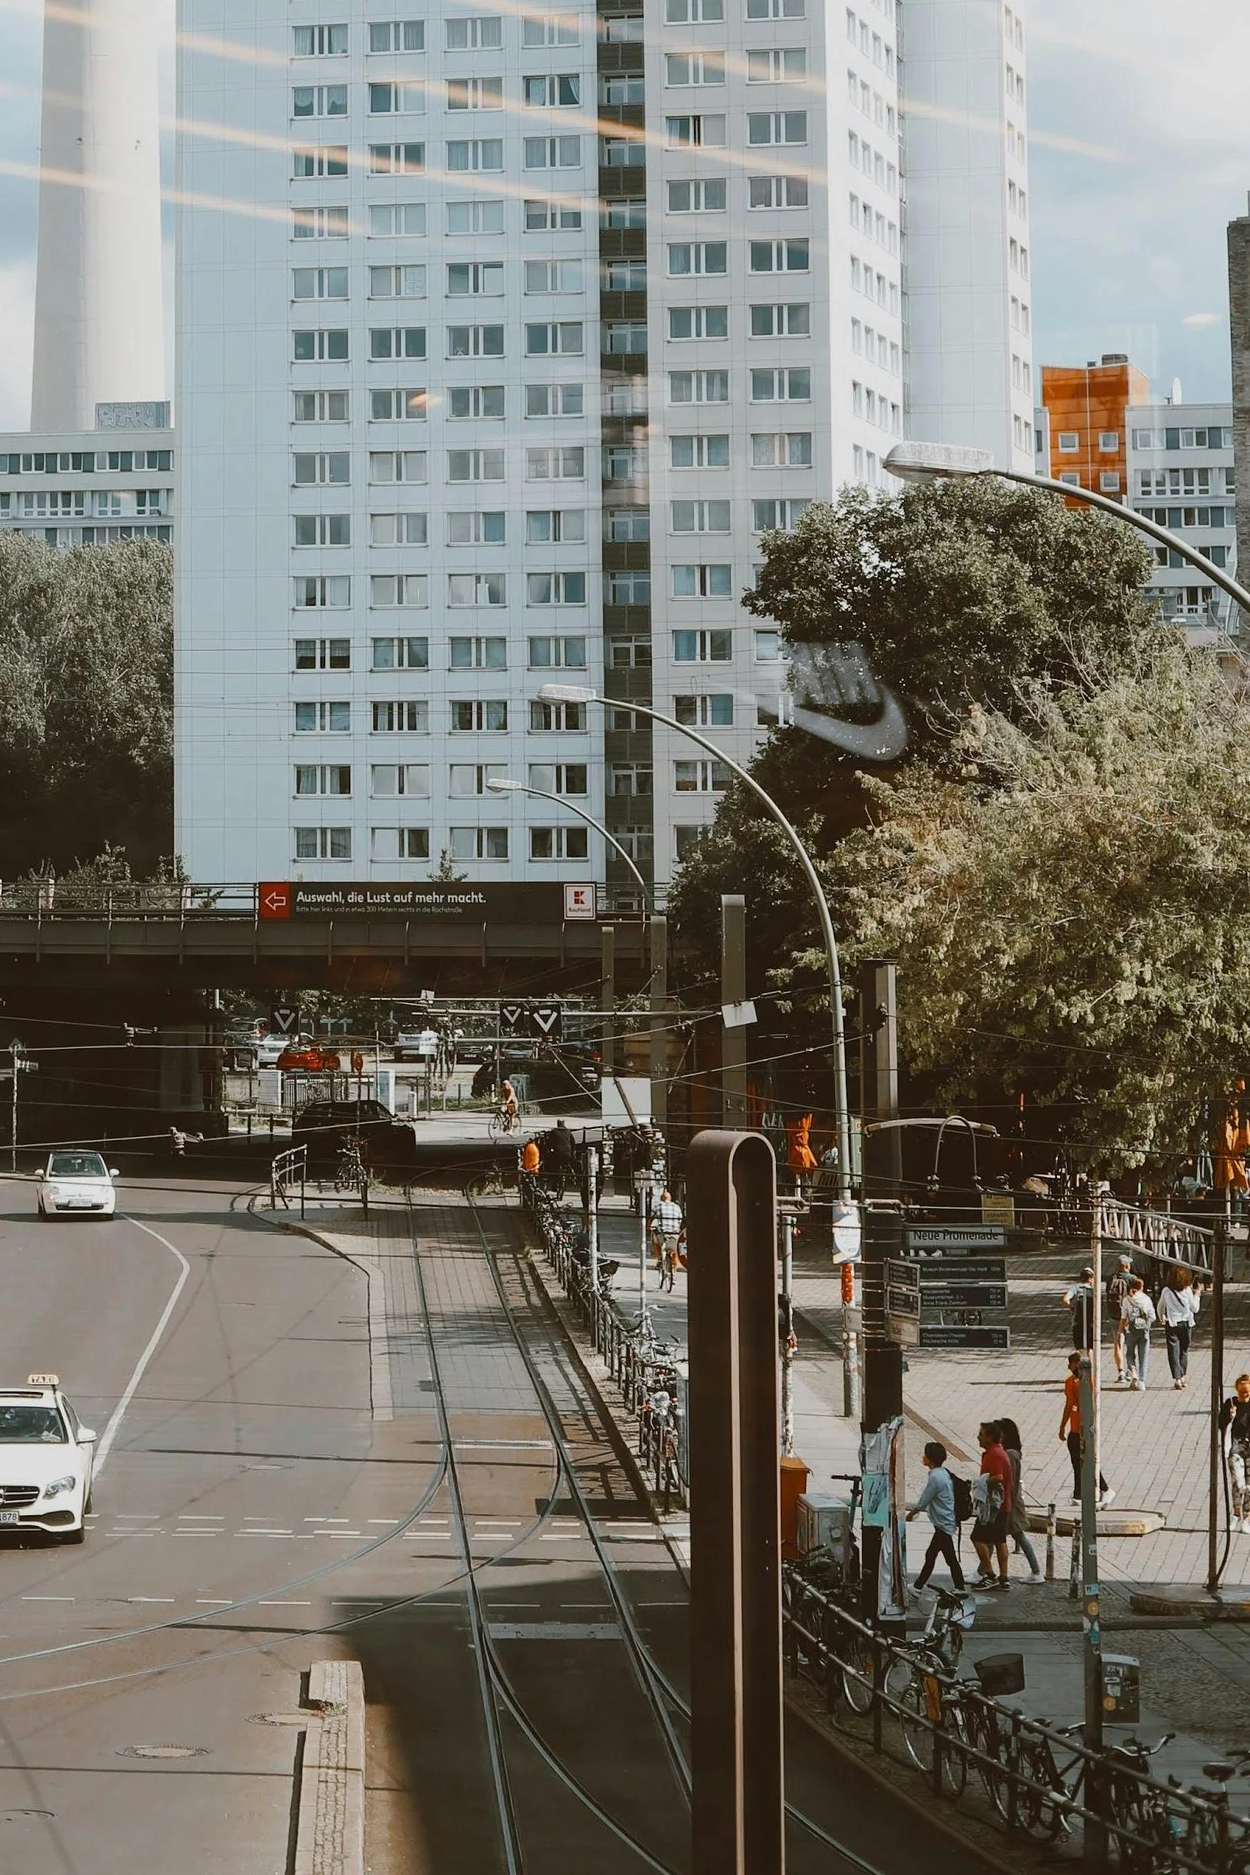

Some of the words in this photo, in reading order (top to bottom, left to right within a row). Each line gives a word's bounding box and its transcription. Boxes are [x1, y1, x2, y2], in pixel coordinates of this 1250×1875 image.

[296, 891, 345, 904] Auswahl,
[347, 891, 364, 903] die
[366, 891, 390, 903] Lust
[393, 891, 413, 903] auf
[415, 891, 445, 903] mehr
[447, 891, 487, 903] macht.
[913, 1229, 940, 1241] Neue
[942, 1228, 999, 1241] Promenade
